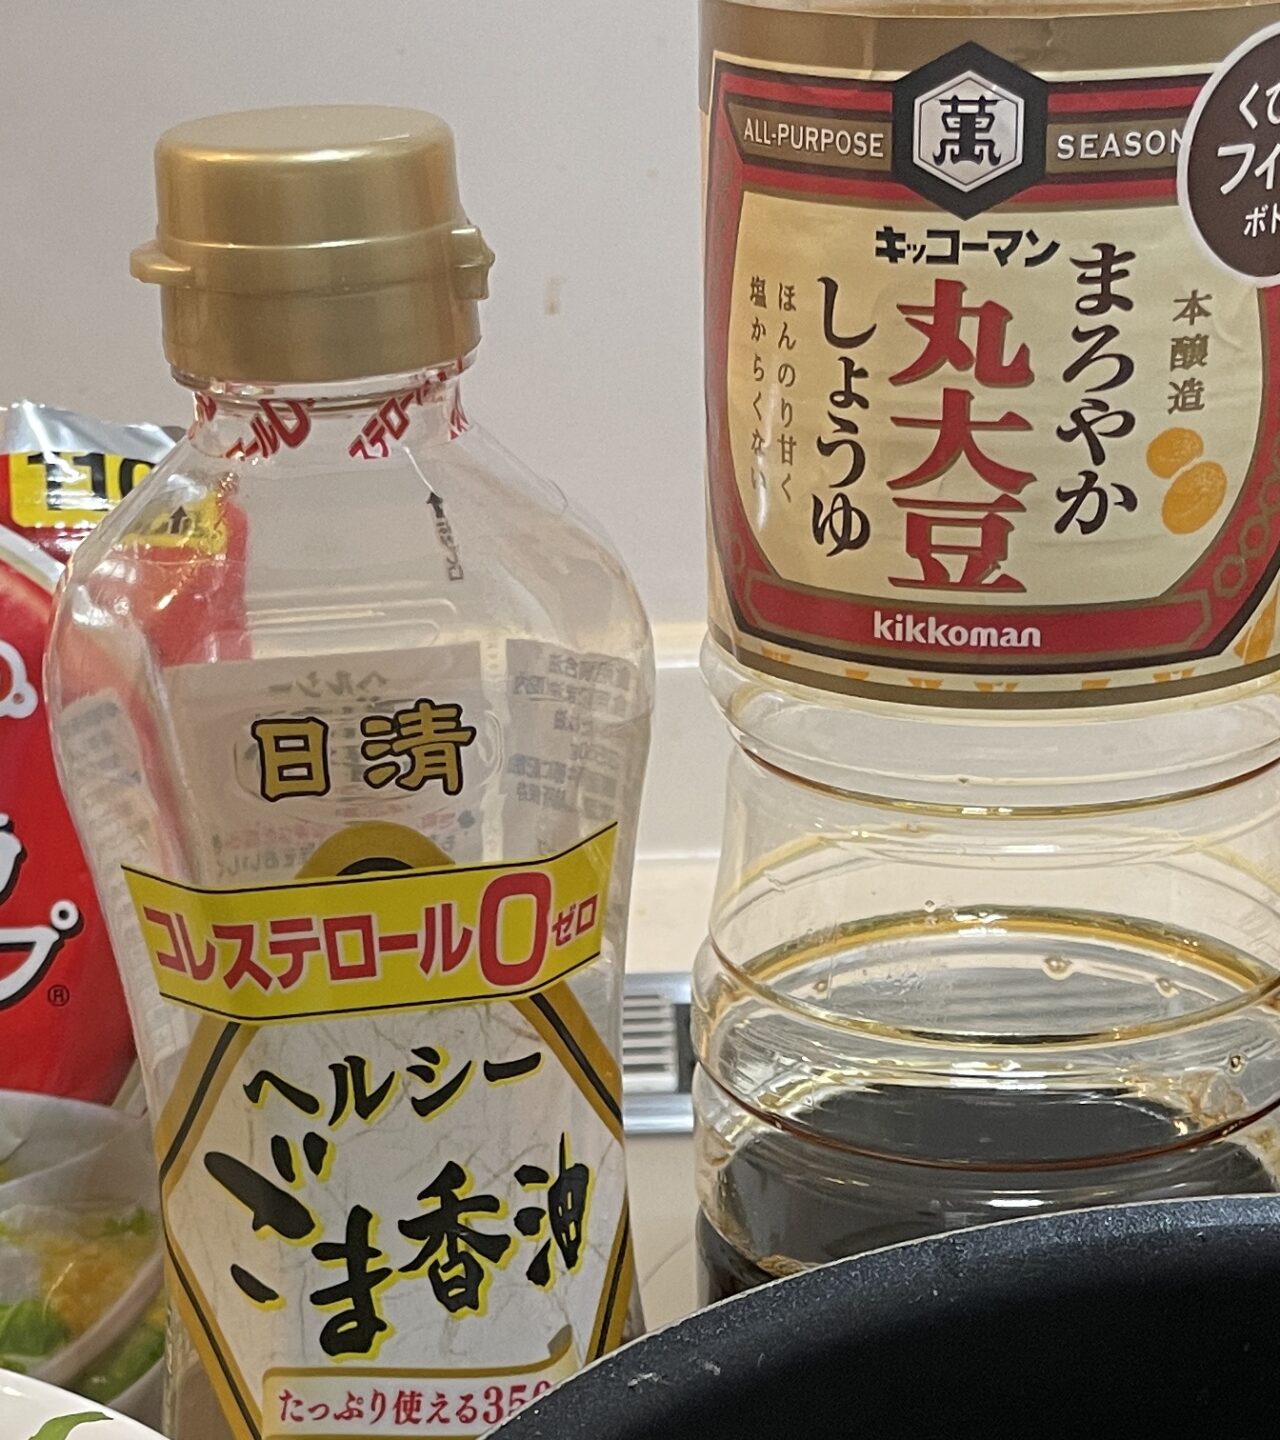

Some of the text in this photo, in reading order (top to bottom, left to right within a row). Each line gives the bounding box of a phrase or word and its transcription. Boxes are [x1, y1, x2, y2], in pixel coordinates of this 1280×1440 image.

[743, 117, 885, 158] ALL-PURPOSE
[875, 226, 1060, 268] キッコーマン
[750, 276, 767, 490] 塩からくない
[778, 282, 797, 503] ほんのり甘く
[812, 276, 877, 557] しょうゆ
[887, 279, 1035, 593] 丸大豆
[1054, 242, 1138, 535] まろやか
[872, 611, 1041, 648] kikkoman
[252, 698, 476, 802] 日清
[243, 1046, 542, 1127] ヘルシー
[204, 1132, 589, 1355] ごま香油
